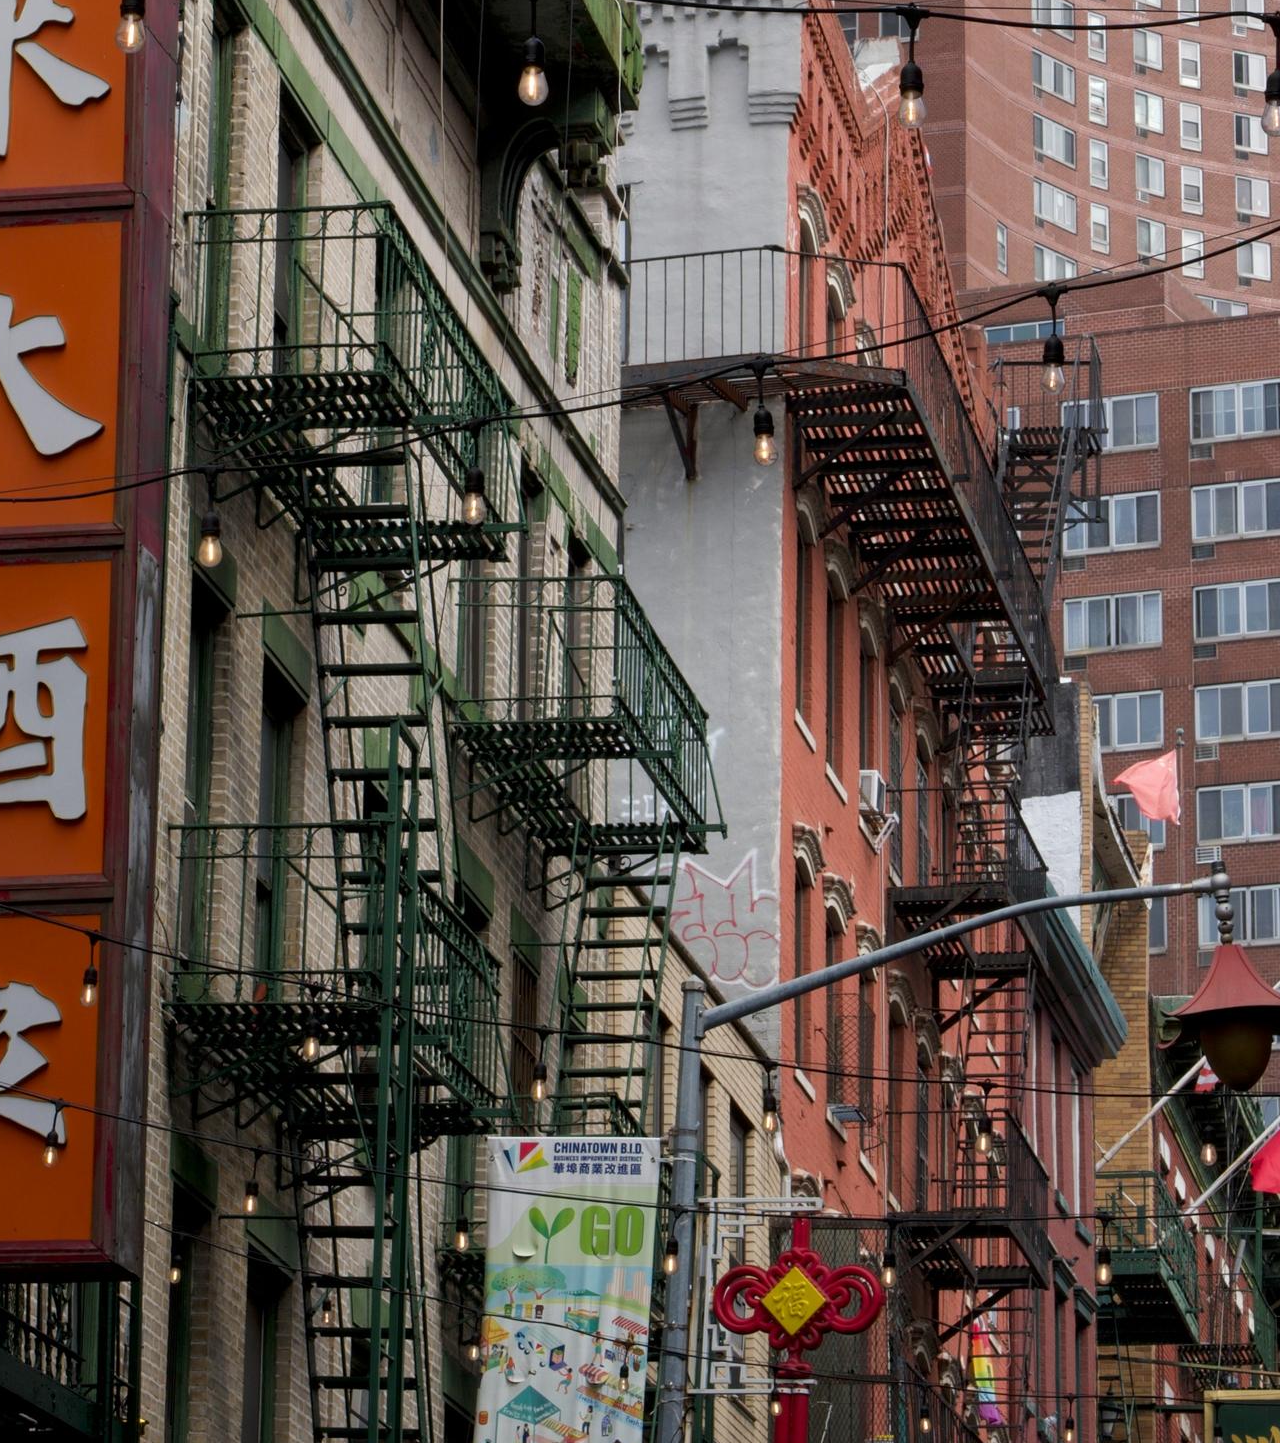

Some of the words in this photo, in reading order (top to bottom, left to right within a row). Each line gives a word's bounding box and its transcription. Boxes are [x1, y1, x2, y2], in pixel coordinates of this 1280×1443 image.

[554, 1142, 618, 1154] CHINATOWN
[620, 1142, 644, 1155] B.I.D.
[578, 1204, 645, 1258] GO
